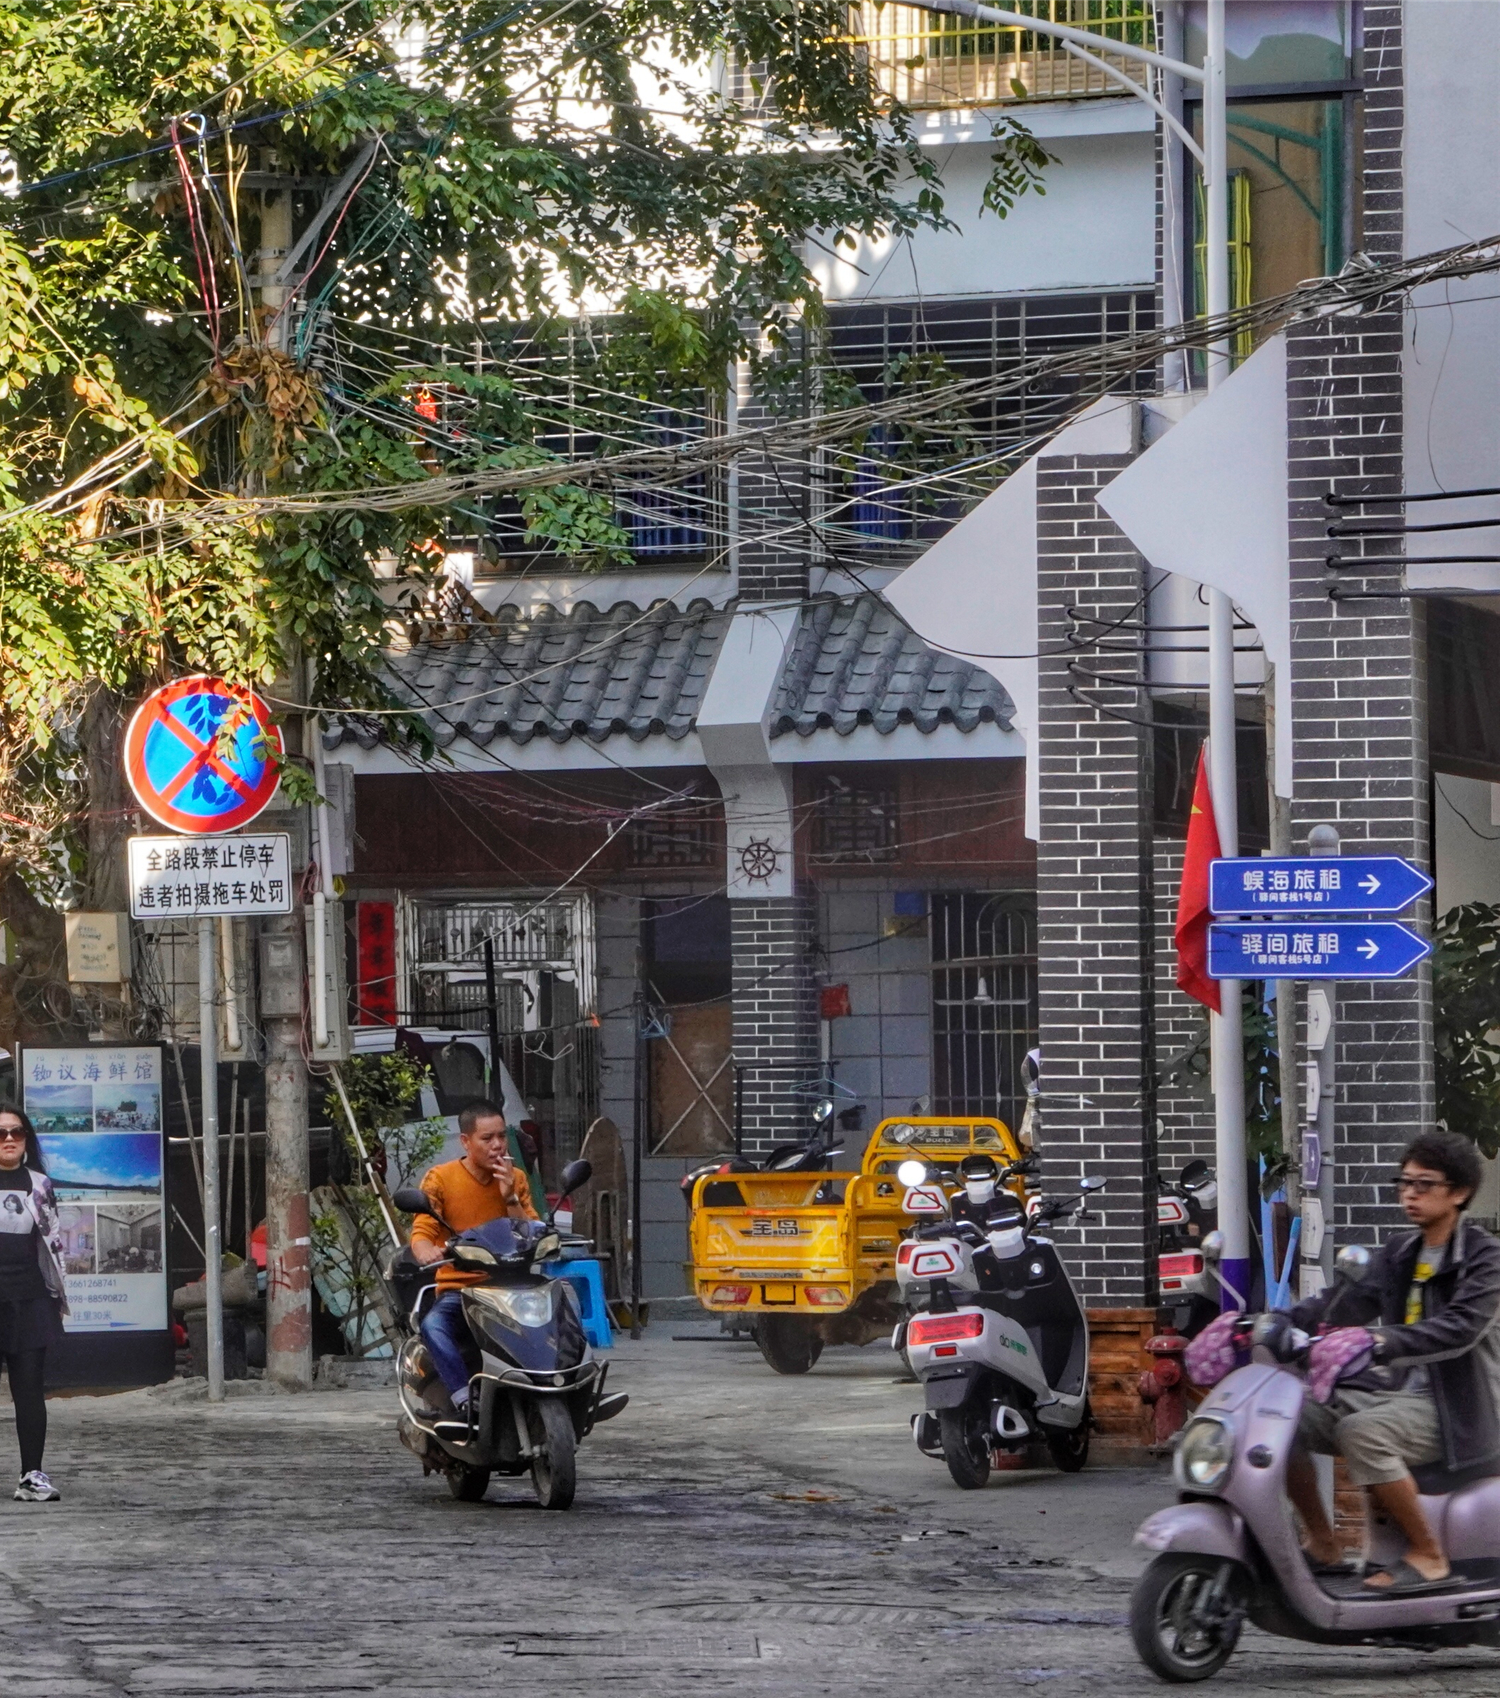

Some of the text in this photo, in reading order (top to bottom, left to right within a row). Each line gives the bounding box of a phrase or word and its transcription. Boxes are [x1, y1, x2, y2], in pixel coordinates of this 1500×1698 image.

[146, 844, 275, 871] 全路段禁止停车
[139, 880, 284, 908] 违者拍摄拖车处罚
[1242, 933, 1339, 954] 驿间旅租
[32, 1061, 153, 1081] 铷议海鲜馆
[752, 1219, 799, 1237] 宝岛
[67, 1294, 128, 1303] 898-88590822
